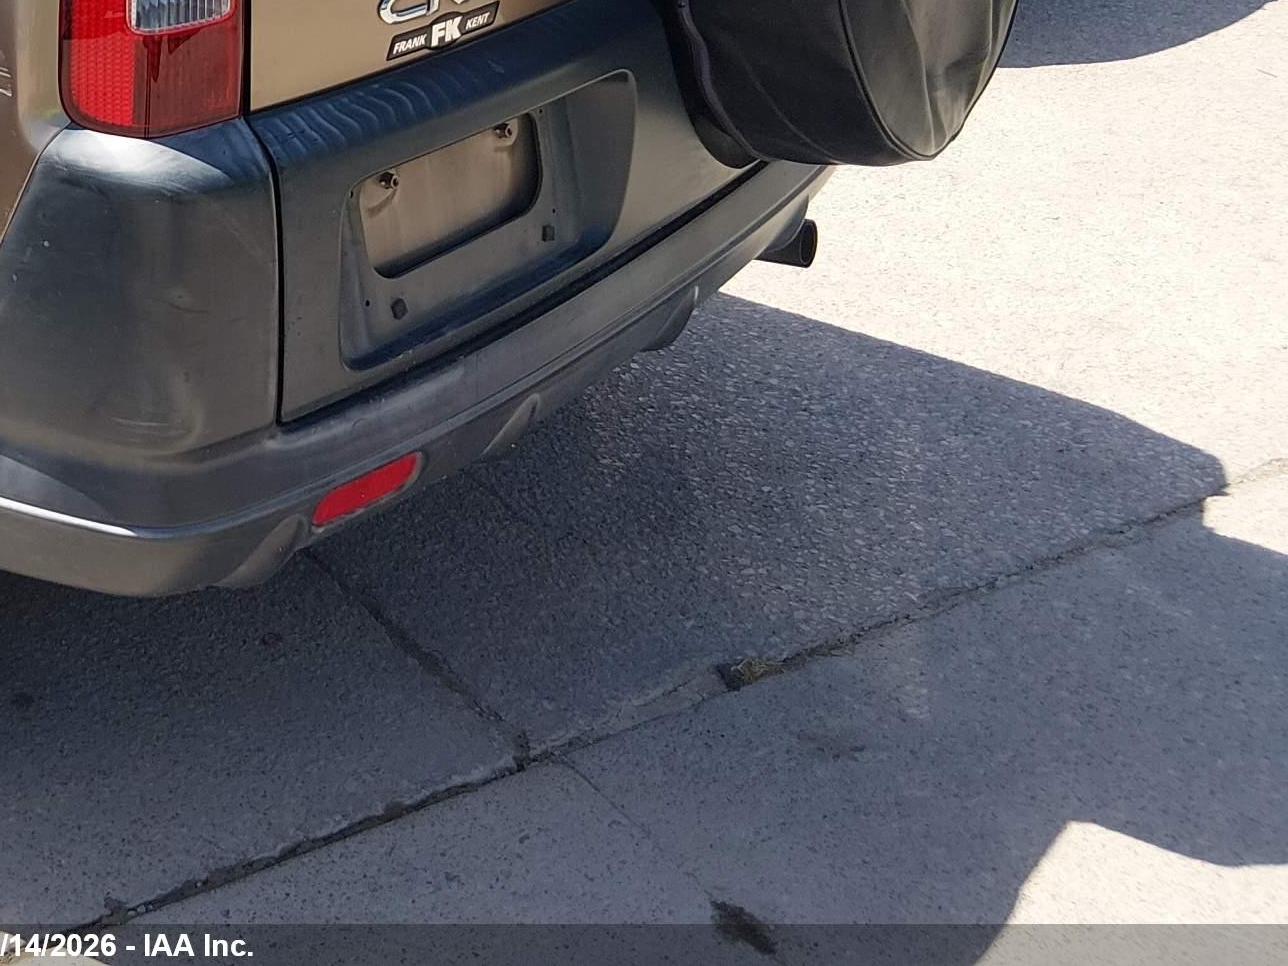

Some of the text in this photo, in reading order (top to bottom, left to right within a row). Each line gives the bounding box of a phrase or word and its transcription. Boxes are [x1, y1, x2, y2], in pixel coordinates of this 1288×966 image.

[392, 12, 491, 55] FRANK FK KENT
